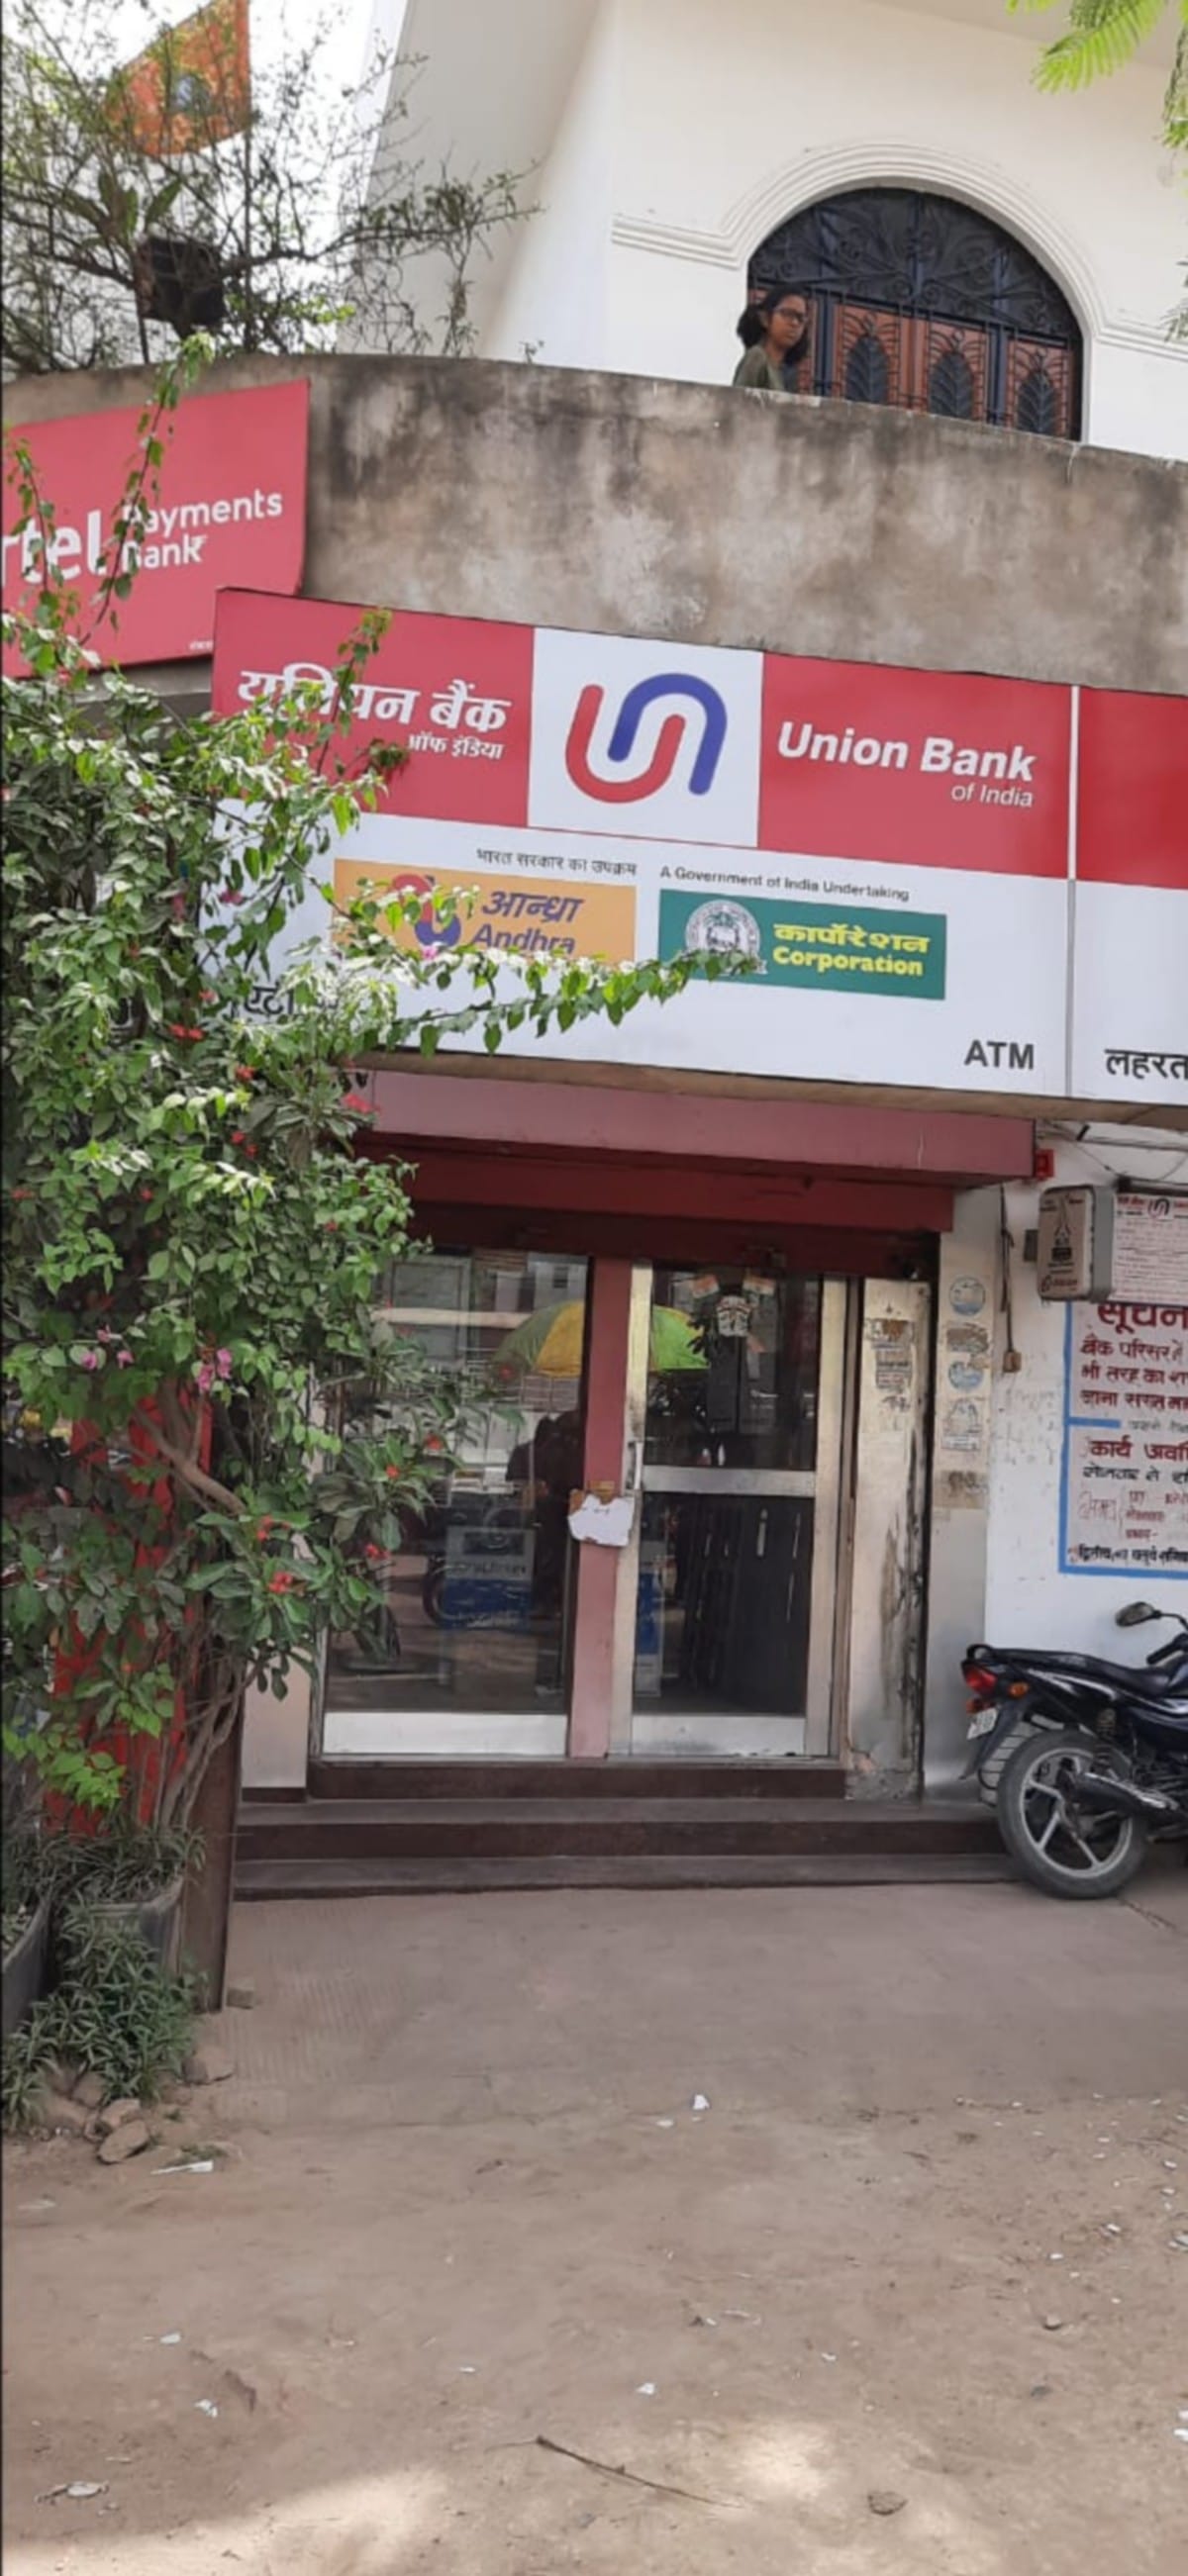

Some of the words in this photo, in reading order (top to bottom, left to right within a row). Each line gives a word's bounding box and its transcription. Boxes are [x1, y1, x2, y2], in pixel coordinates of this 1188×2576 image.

[123, 489, 283, 538] Payments
[430, 679, 513, 733] बैंक
[451, 734, 504, 760] इंडिया
[777, 721, 908, 769] Union
[920, 736, 1037, 782] Bank
[950, 782, 981, 803] of
[979, 784, 1034, 808] India
[476, 848, 514, 866] भारत
[517, 852, 564, 871] सरकार
[567, 857, 588, 873] का
[592, 859, 638, 877] उपक्रम
[660, 866, 671, 879] A
[675, 867, 763, 888] Government
[765, 877, 781, 890] of
[784, 877, 820, 893] India
[823, 881, 910, 903] Undertaking
[481, 890, 584, 923] आन्ध्रा
[472, 922, 576, 955] Andhra
[772, 946, 925, 977] Corporation
[964, 1038, 1036, 1070] ATM
[1090, 1434, 1134, 1459] कार्य
